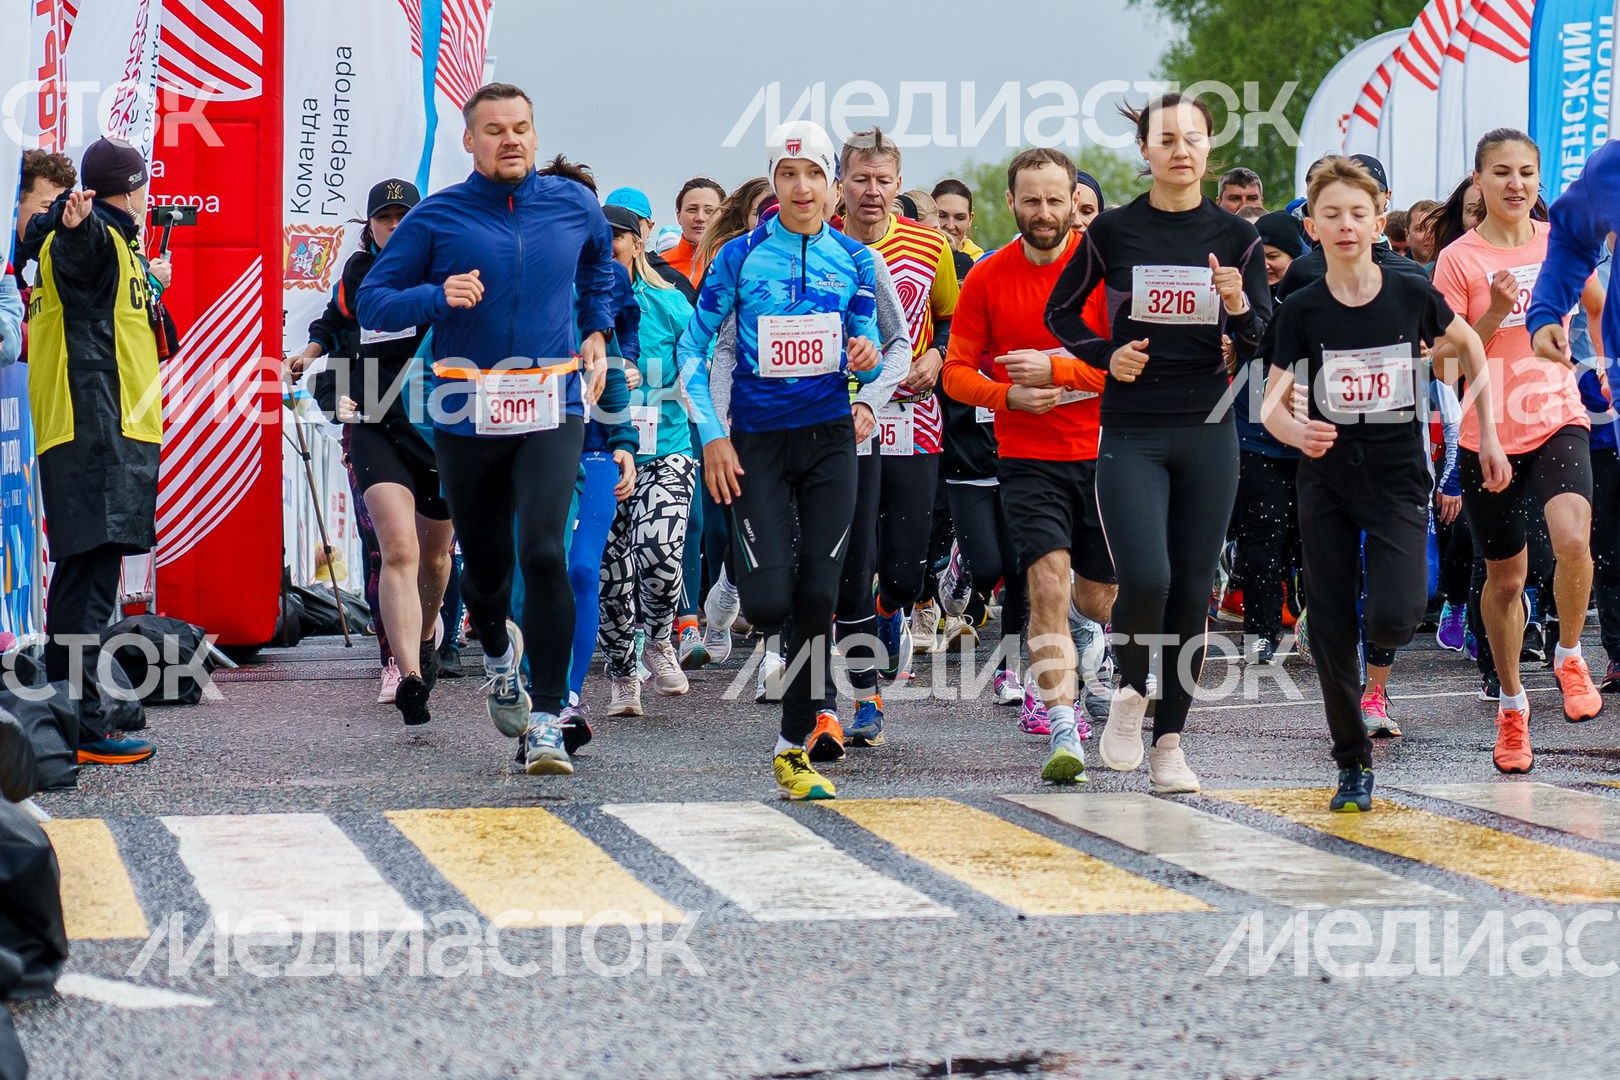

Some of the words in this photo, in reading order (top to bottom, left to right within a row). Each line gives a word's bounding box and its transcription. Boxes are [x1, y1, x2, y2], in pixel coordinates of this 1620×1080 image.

[321, 45, 356, 217] Губернатора
[290, 97, 320, 215] Команда
[1148, 289, 1196, 315] 3216
[770, 339, 824, 366] 3088
[1341, 372, 1391, 402] 3178
[490, 398, 537, 424] 3001
